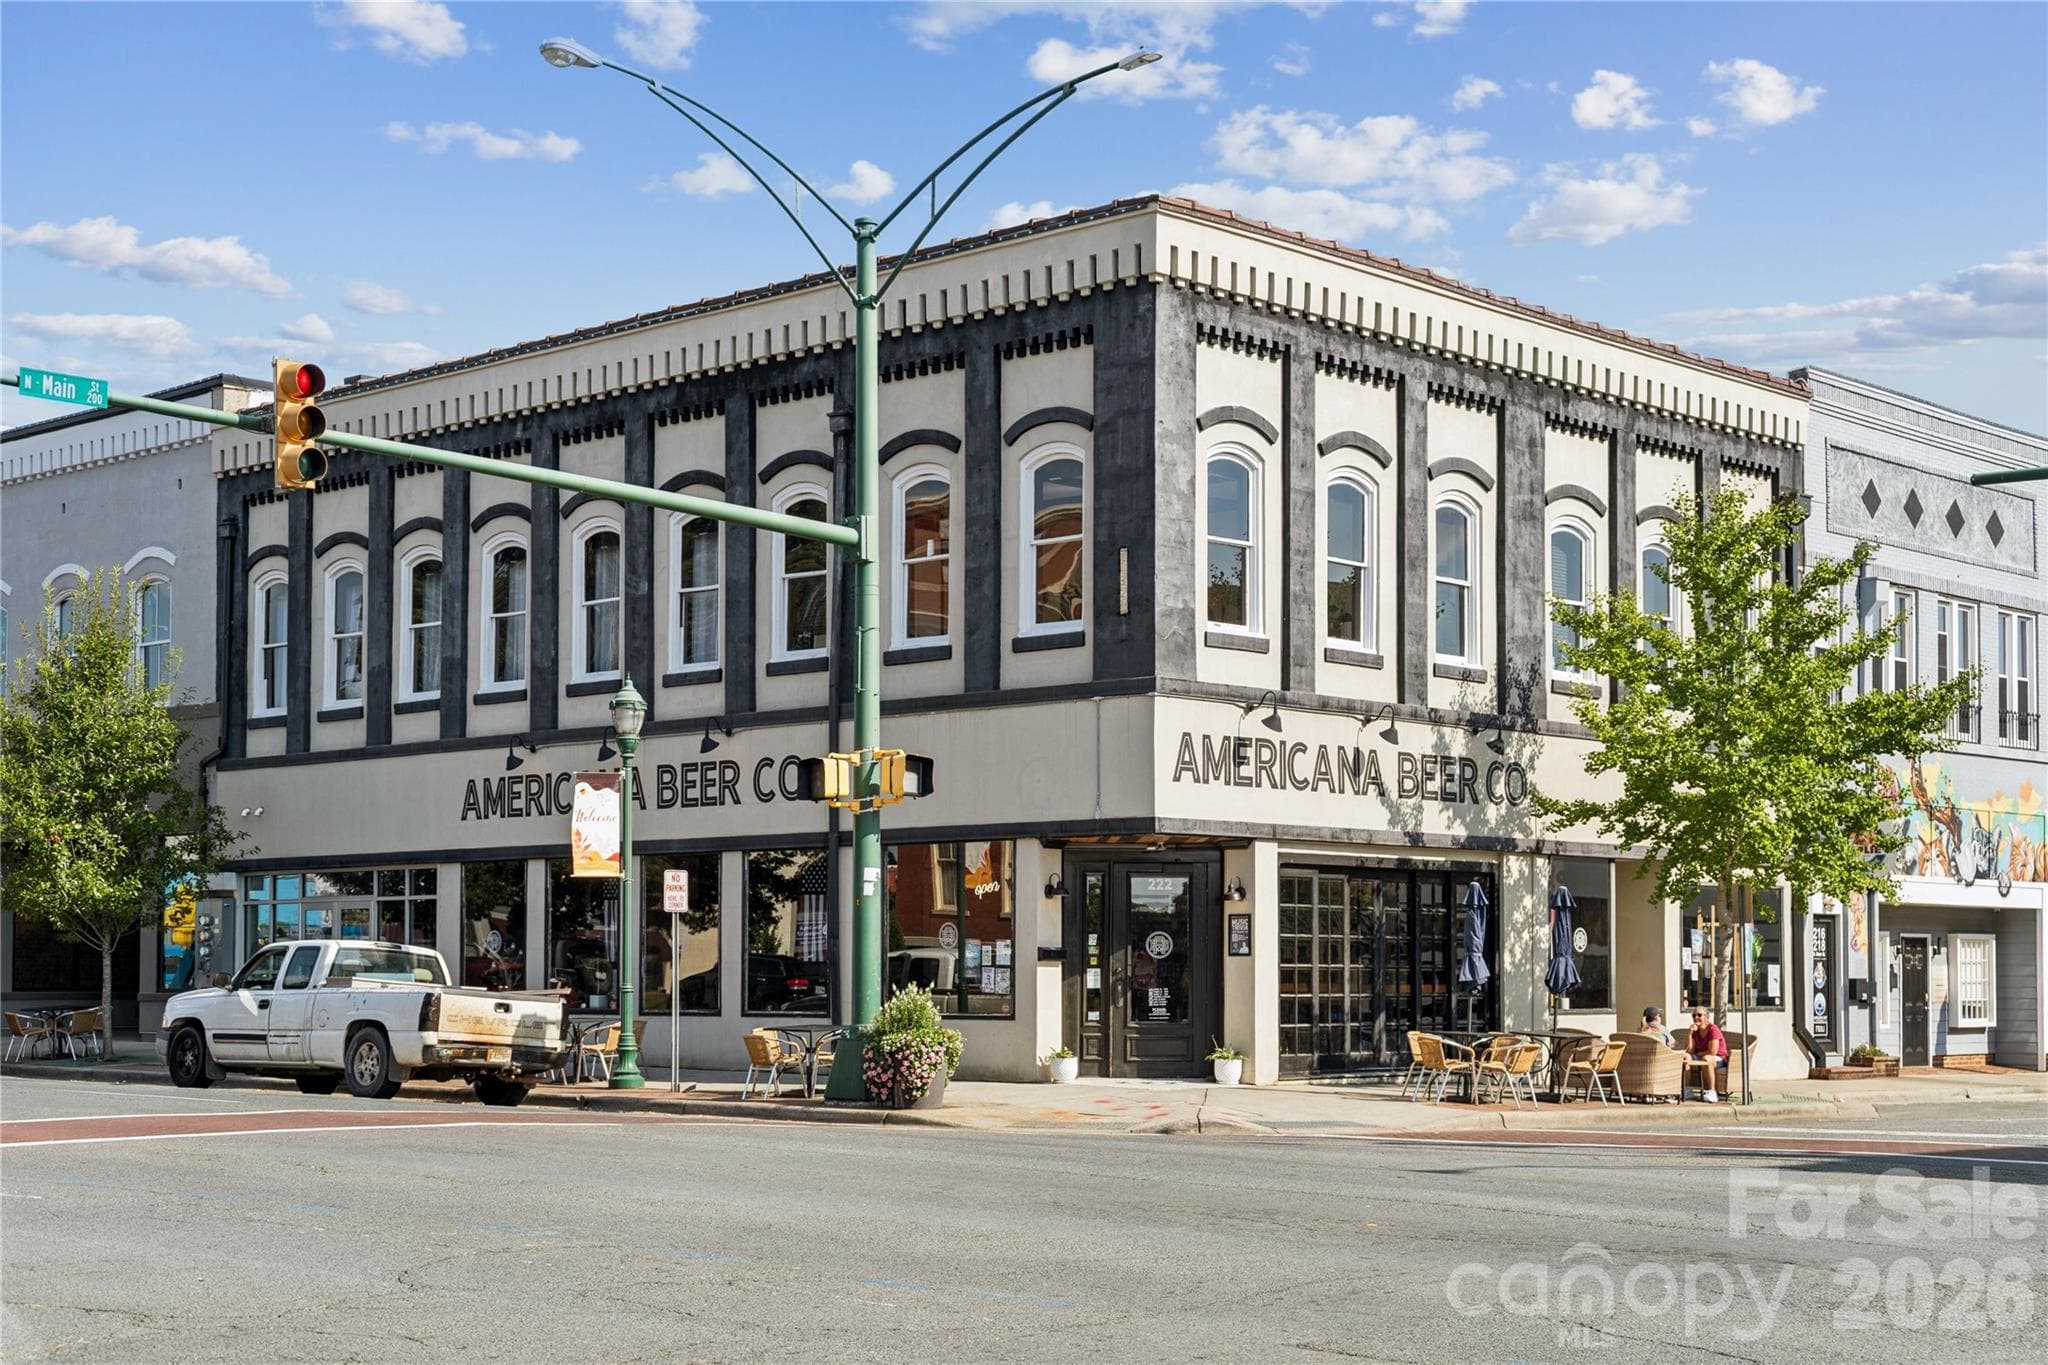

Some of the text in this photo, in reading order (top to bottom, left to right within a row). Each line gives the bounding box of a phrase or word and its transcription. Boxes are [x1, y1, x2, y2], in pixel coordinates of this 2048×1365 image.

[42, 374, 76, 399] Main
[90, 381, 100, 393] St
[87, 392, 103, 405] 200
[1172, 732, 1529, 807] AMERICANA BEER CO
[461, 754, 801, 821] AMERICA BEER CO
[575, 808, 616, 822] Welcome
[671, 873, 681, 882] NO
[1147, 878, 1173, 890] 222
[665, 884, 686, 892] PARKING
[974, 881, 1000, 899] open
[1813, 928, 1826, 939] 216
[1813, 939, 1826, 951] 218
[447, 1014, 556, 1030] CHEVROLET
